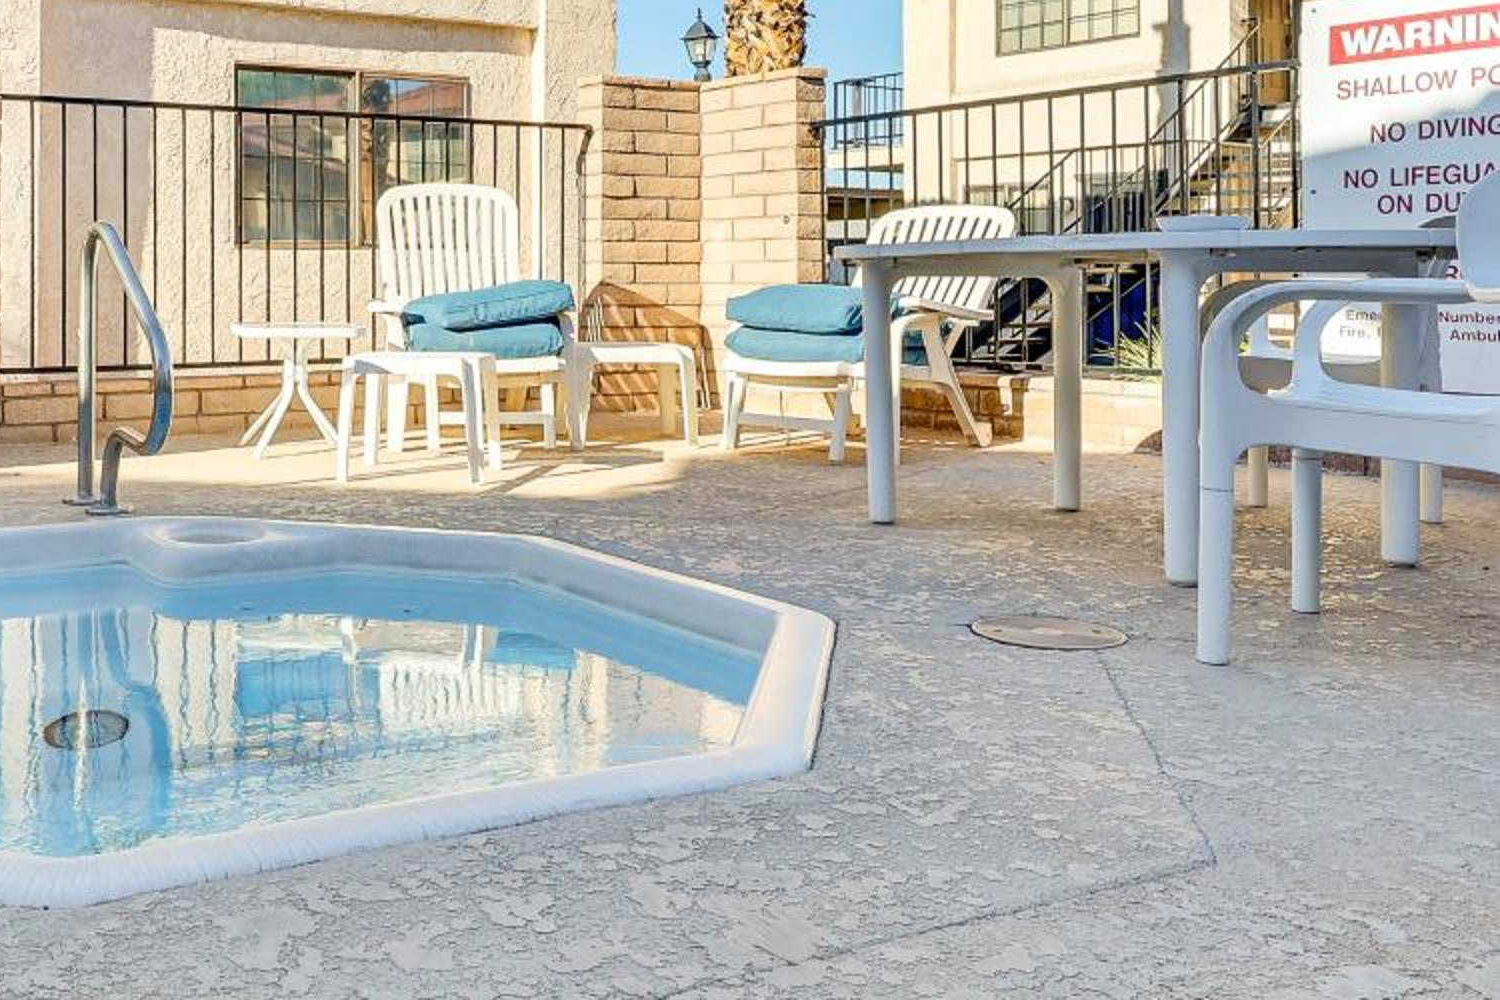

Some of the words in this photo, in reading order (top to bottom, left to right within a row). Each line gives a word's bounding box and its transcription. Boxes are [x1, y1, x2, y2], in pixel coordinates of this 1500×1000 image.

[1337, 69, 1459, 101] SHALLOW
[1370, 122, 1406, 144] NO
[1418, 114, 1500, 141] DIVING
[1343, 169, 1379, 189] NO
[1377, 193, 1414, 215] ON
